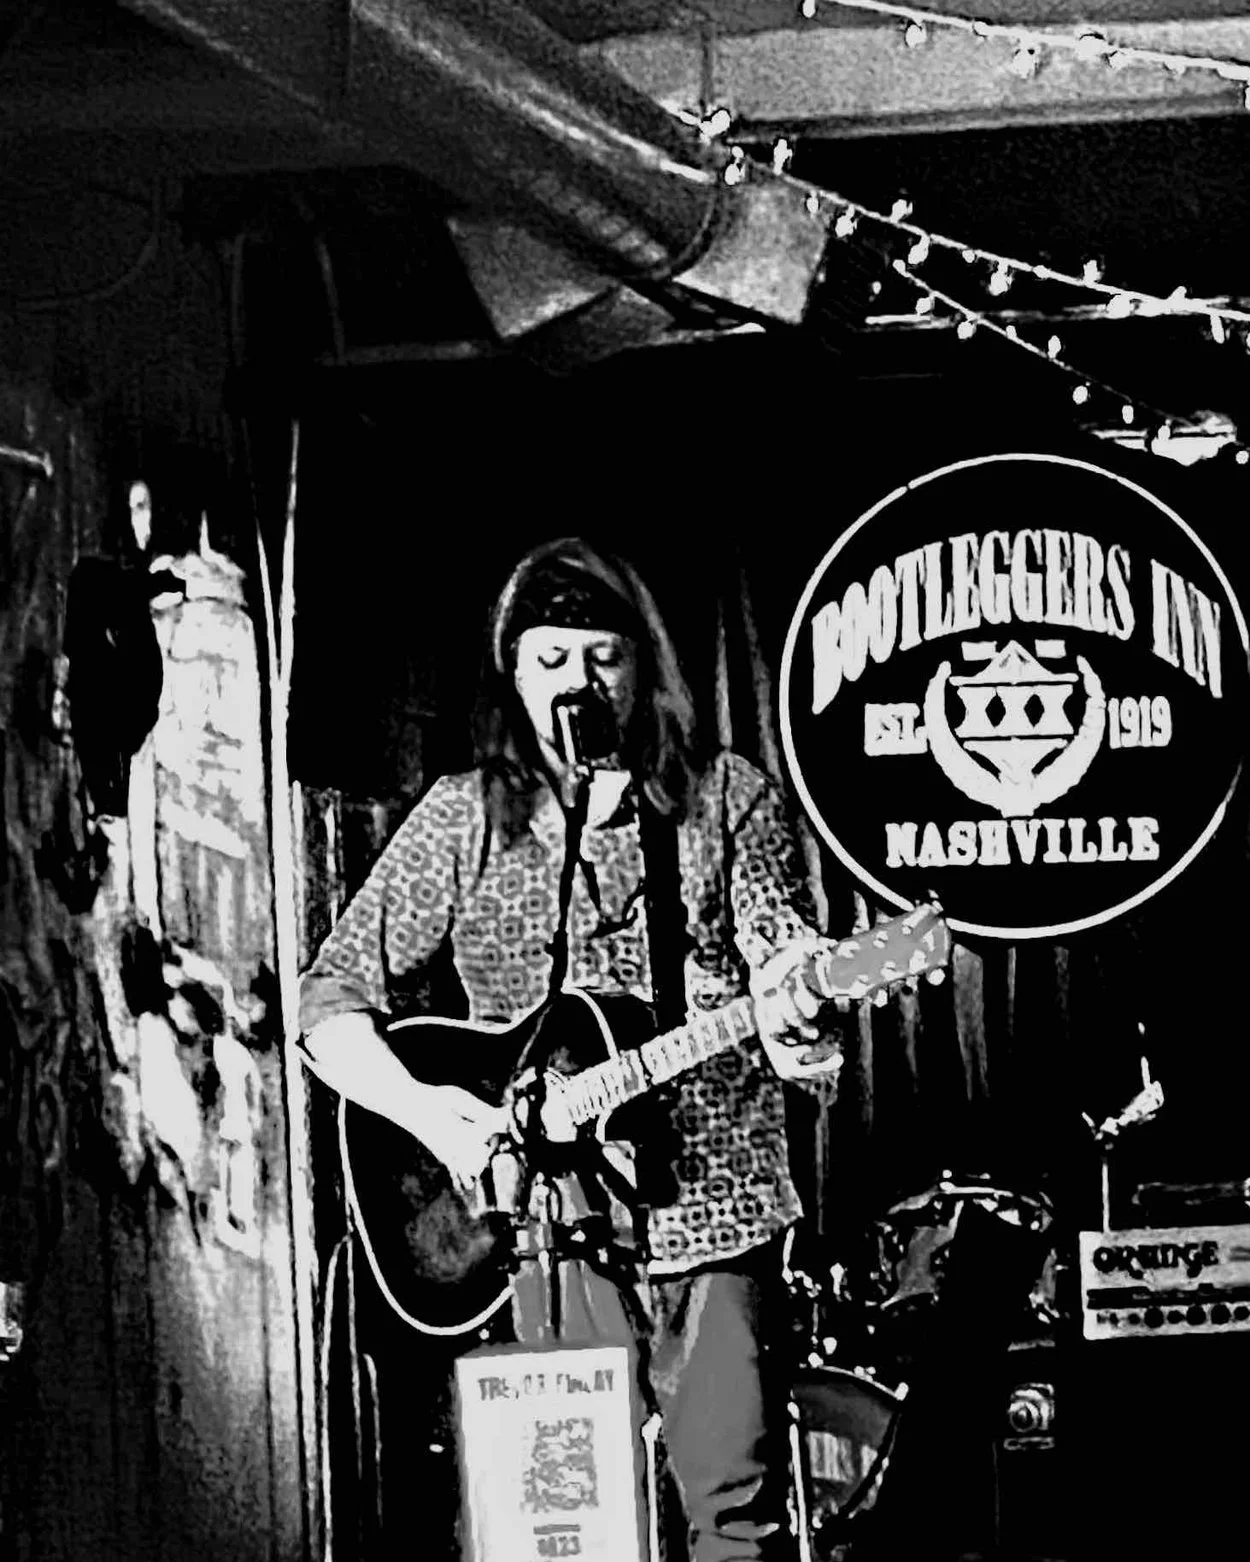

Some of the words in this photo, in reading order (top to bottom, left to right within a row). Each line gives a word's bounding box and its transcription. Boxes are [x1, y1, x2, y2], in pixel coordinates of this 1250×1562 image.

[811, 528, 1135, 715] BOOTLEGGERS
[1150, 558, 1223, 699] INN
[1108, 695, 1173, 749] 1919
[885, 816, 1160, 868] NASHVILLE
